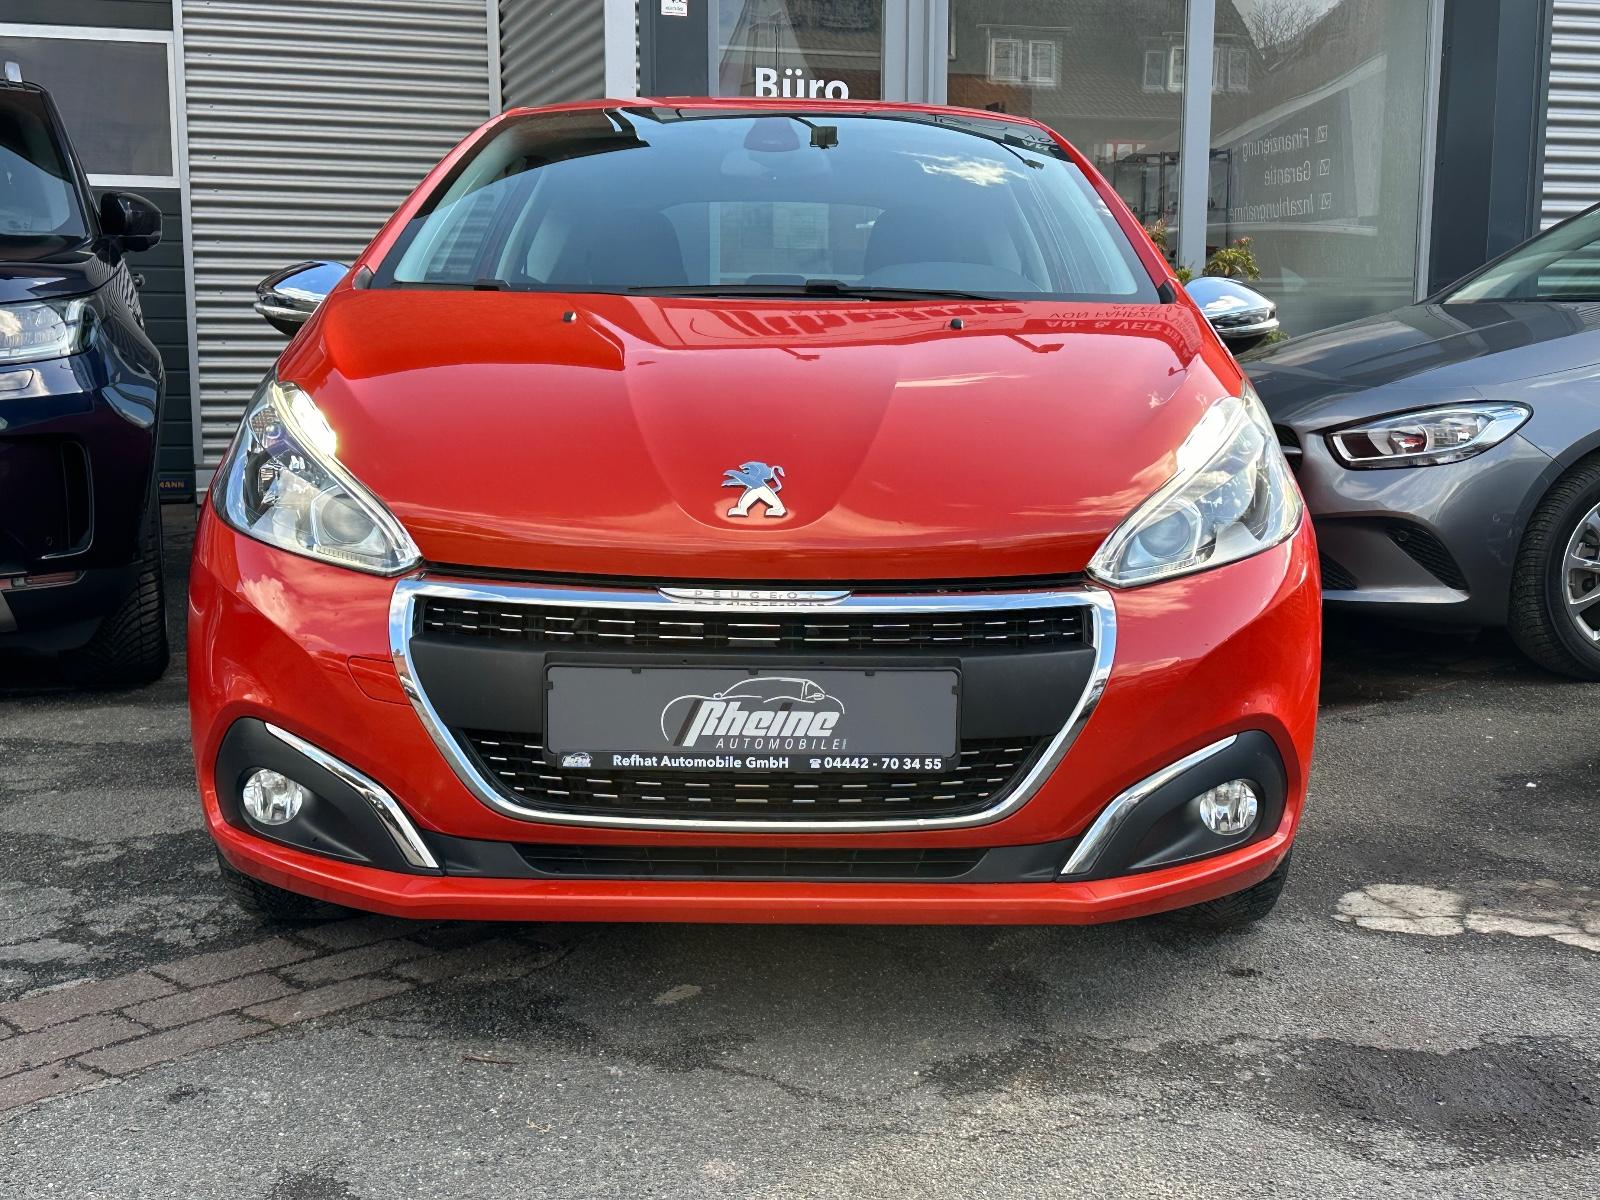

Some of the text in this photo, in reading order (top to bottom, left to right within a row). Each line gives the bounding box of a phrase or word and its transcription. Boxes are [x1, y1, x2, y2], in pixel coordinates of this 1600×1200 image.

[755, 67, 849, 99] Büro
[694, 589, 817, 599] PEUGEOT
[682, 701, 840, 747] Rheine
[716, 738, 840, 750] AUTOMOBILE
[612, 755, 658, 767] Refhat
[660, 755, 742, 768] Automobile
[745, 757, 789, 769] GmbH
[824, 757, 869, 769] 04442
[881, 757, 900, 770] 70
[903, 758, 921, 770] 34
[924, 758, 942, 770] 55
